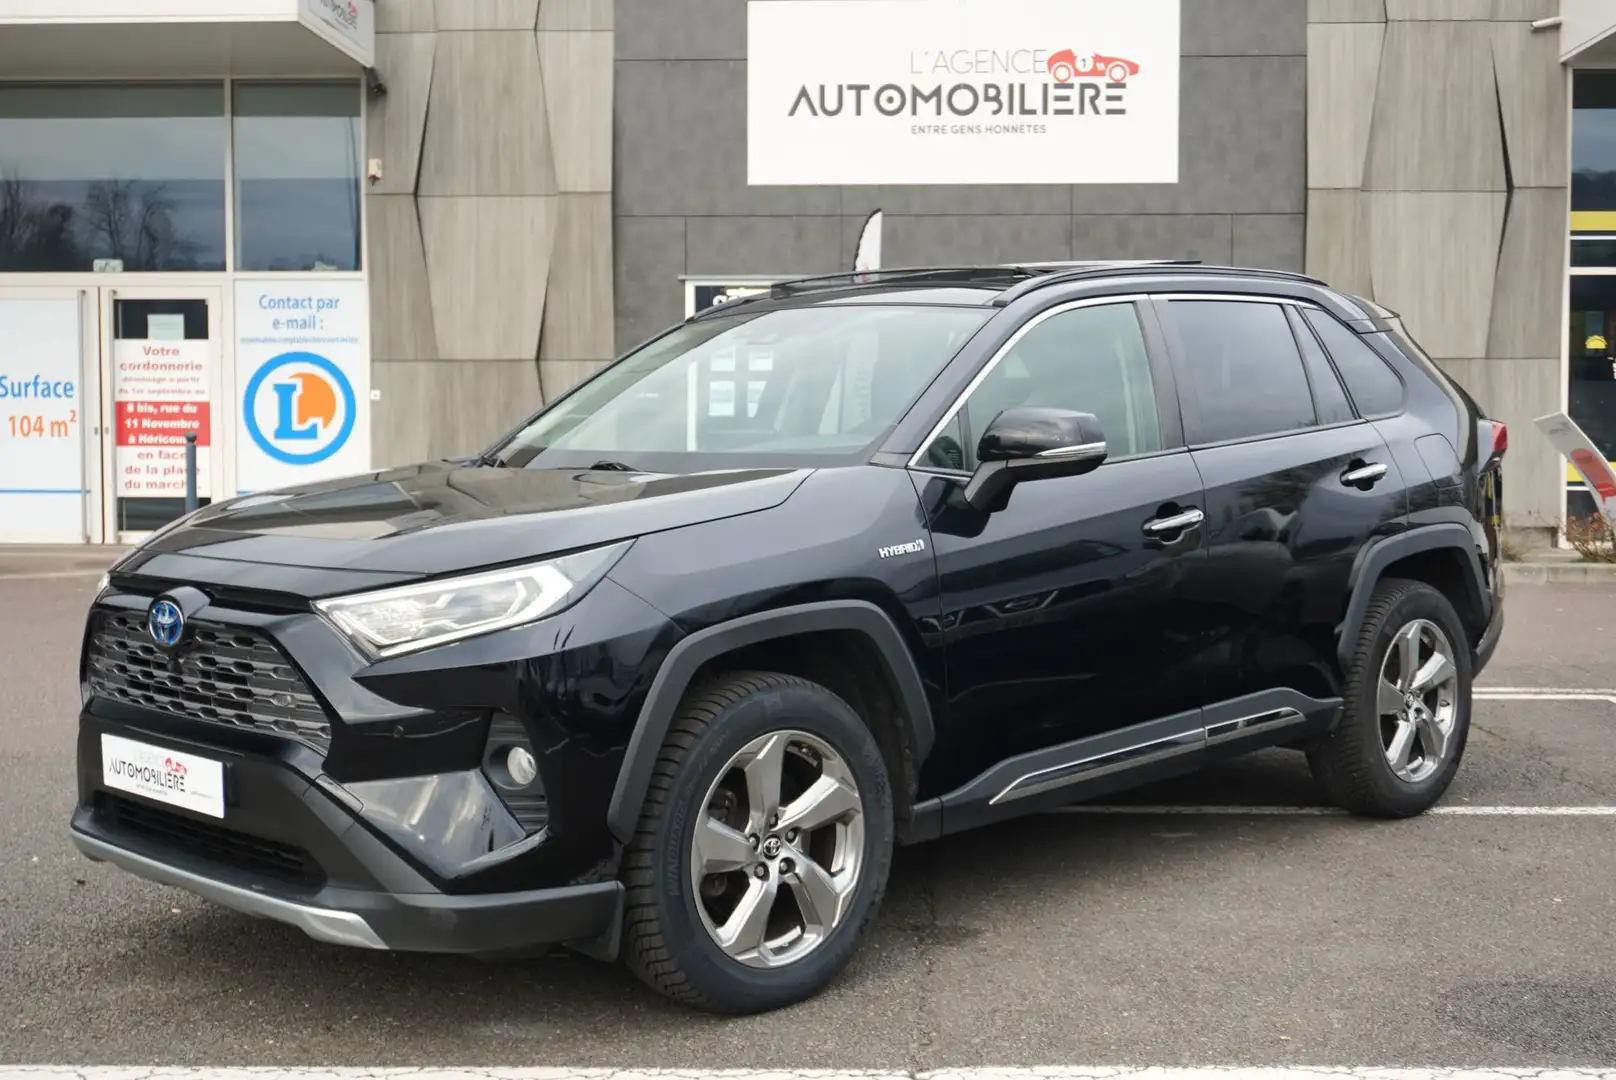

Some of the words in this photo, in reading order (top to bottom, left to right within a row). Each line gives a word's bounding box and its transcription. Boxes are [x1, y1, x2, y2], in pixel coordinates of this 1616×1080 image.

[910, 49, 1047, 75] L'AGENCE
[911, 124, 947, 135] ENTRE
[950, 124, 982, 135] GENS
[258, 294, 312, 310] Contact
[316, 298, 340, 312] par
[272, 315, 316, 330] e-mail
[143, 346, 180, 357] Votre
[120, 361, 203, 372] cordonnerie
[0, 374, 74, 399] Surface
[137, 402, 157, 414] bis,
[160, 404, 179, 413] rue
[182, 402, 198, 413] du
[8, 415, 44, 437] 104
[125, 418, 138, 429] 11
[142, 418, 200, 429] Novembre
[137, 451, 153, 460] en
[124, 464, 141, 474] de
[146, 464, 158, 474] la
[124, 479, 141, 489] du
